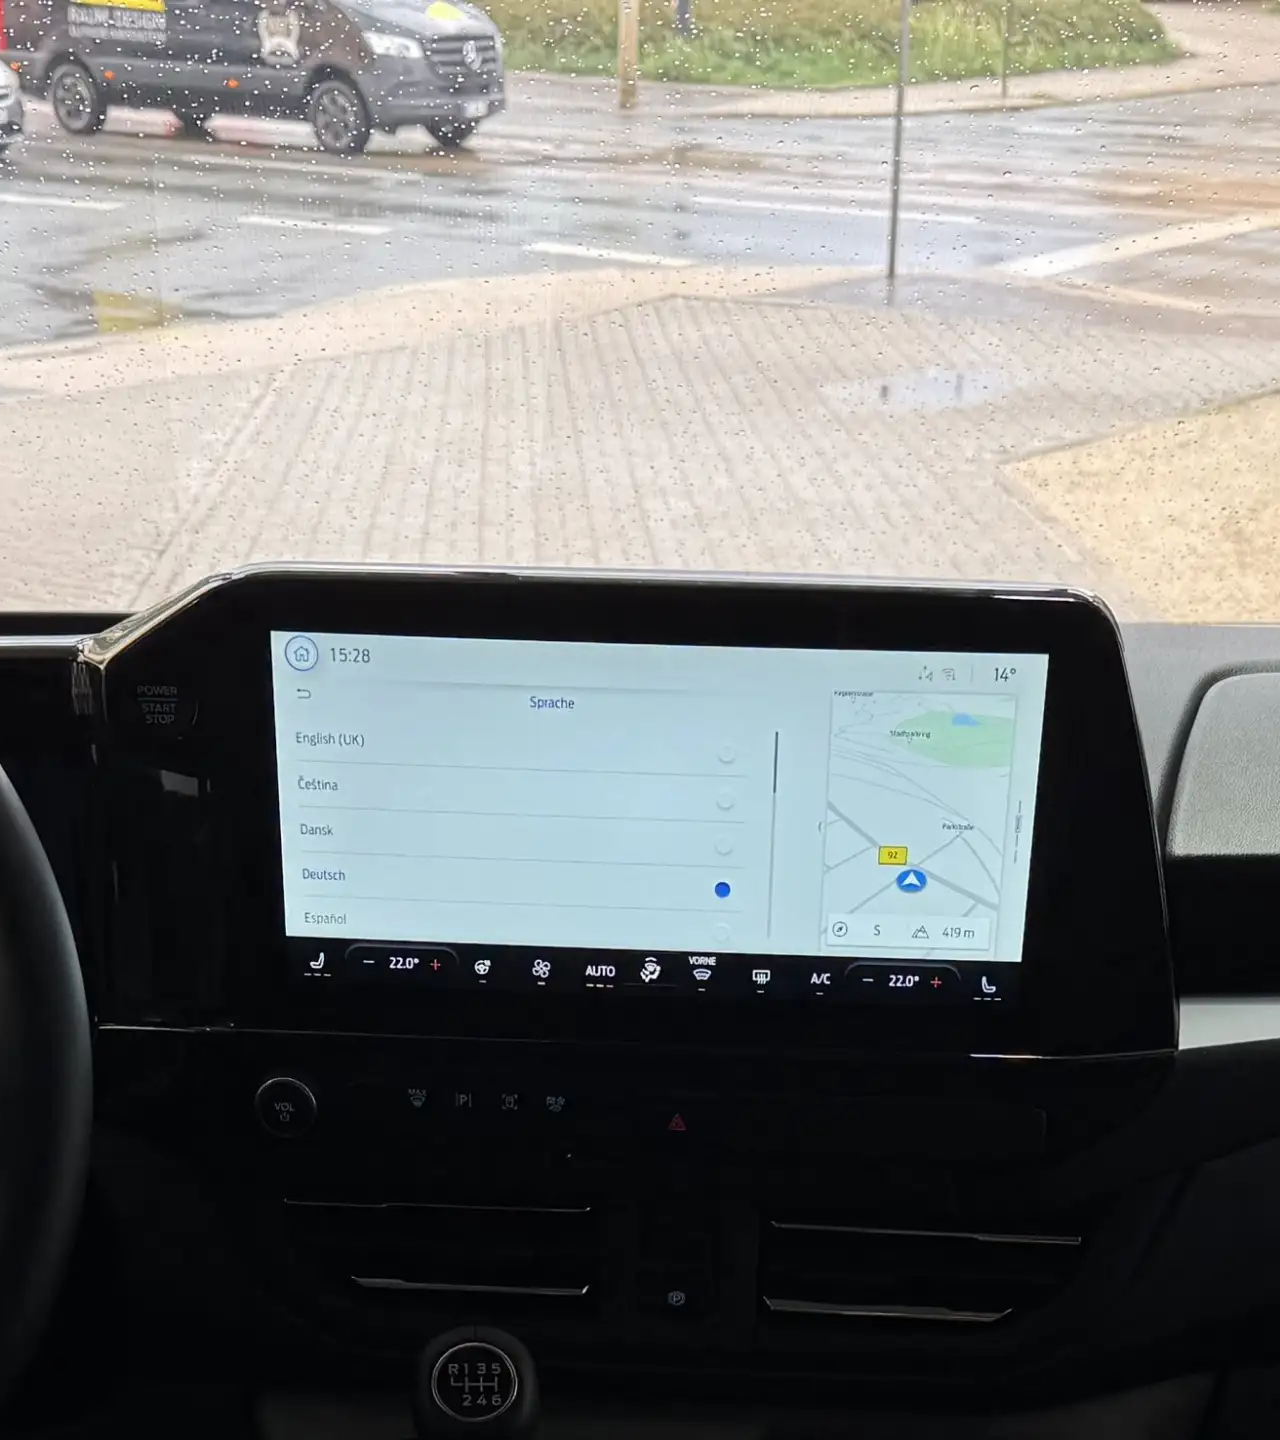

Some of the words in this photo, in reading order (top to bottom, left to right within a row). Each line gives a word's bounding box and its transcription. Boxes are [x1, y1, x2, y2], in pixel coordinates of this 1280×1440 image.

[330, 646, 371, 664] 15:28
[994, 667, 1017, 682] 14°
[136, 685, 178, 696] POWER
[141, 702, 176, 713] START
[529, 695, 575, 711] Sprache
[145, 713, 175, 724] STOP
[295, 731, 336, 748] English
[338, 732, 365, 748] (UK)
[297, 774, 339, 791] Čeština
[300, 823, 334, 836] Dansk
[887, 850, 899, 860] 92
[302, 867, 346, 881] Deutsch
[304, 911, 347, 926] Español
[873, 925, 881, 937] S
[941, 927, 962, 939] 419
[963, 928, 975, 939] m
[388, 955, 420, 971] 22.0°
[688, 956, 718, 966] VORNE
[584, 963, 616, 978] AUTO
[810, 972, 832, 986] A/C
[888, 974, 920, 988] 22.0°
[274, 1102, 295, 1113] VOL
